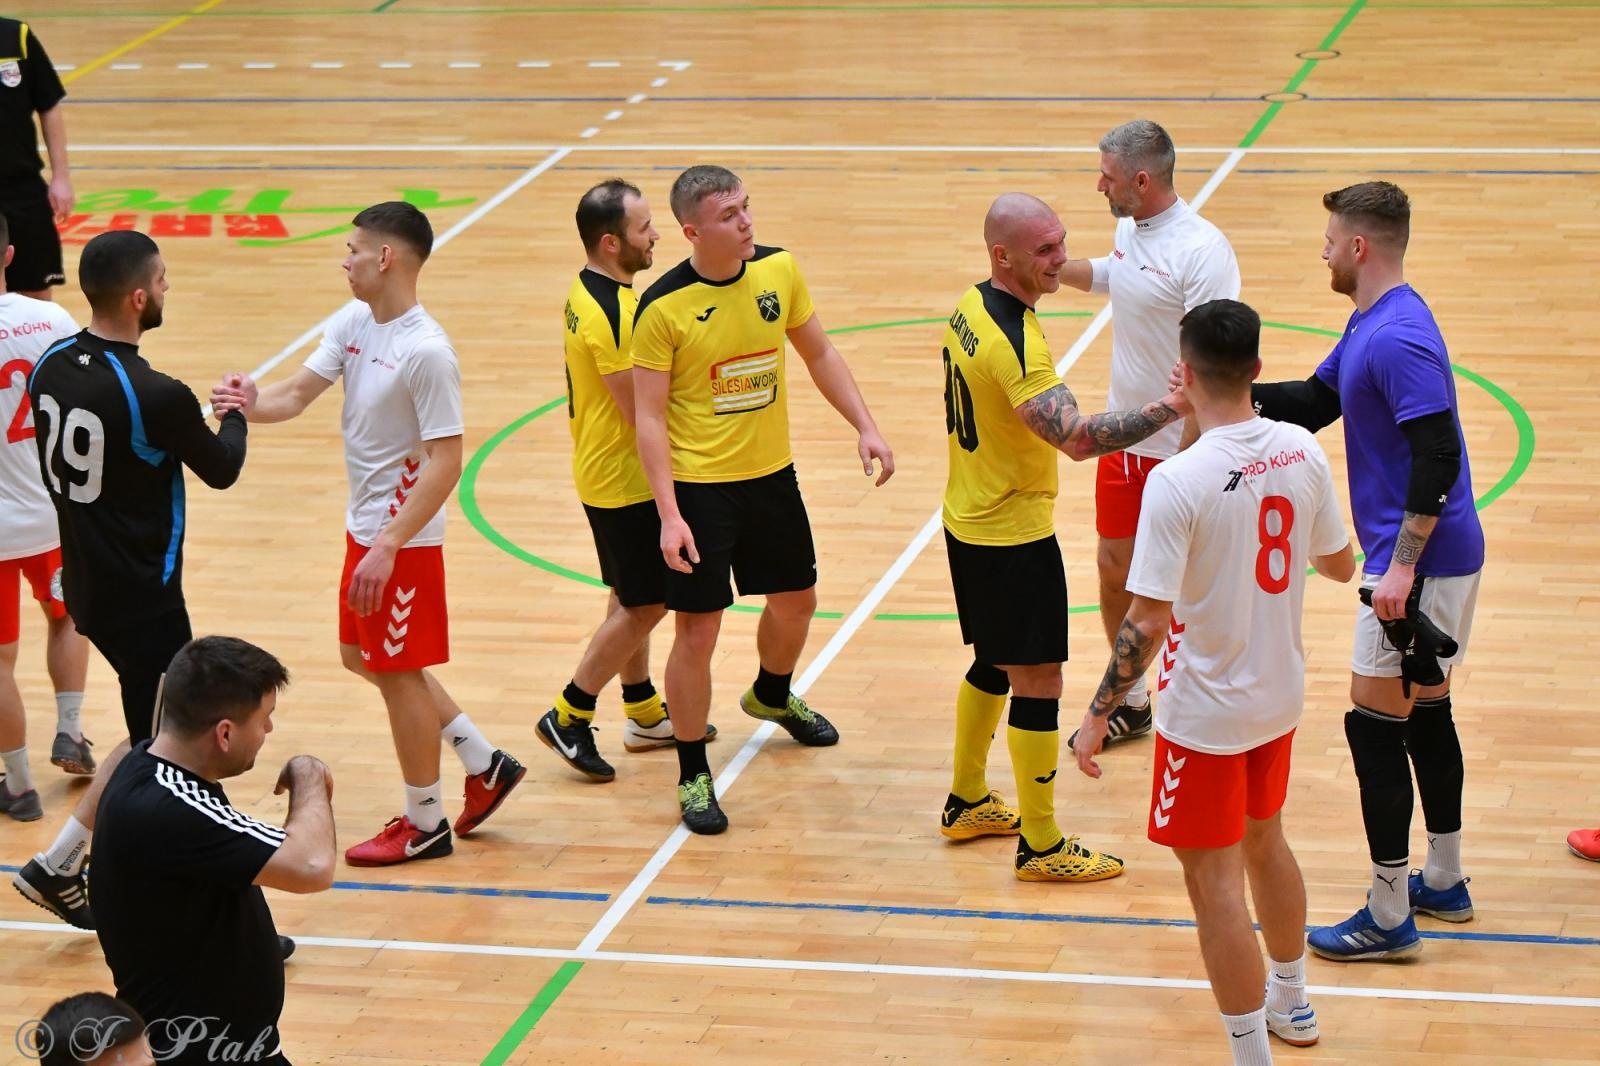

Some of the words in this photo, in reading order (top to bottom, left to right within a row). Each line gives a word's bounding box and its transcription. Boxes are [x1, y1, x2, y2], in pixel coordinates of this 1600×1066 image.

[12, 321, 53, 337] KÜHN
[711, 370, 778, 396] SILESIAWORK
[0, 358, 37, 444] 2
[1241, 460, 1267, 477] PRD
[1269, 448, 1307, 470] KÜHN
[1255, 495, 1295, 595] 8
